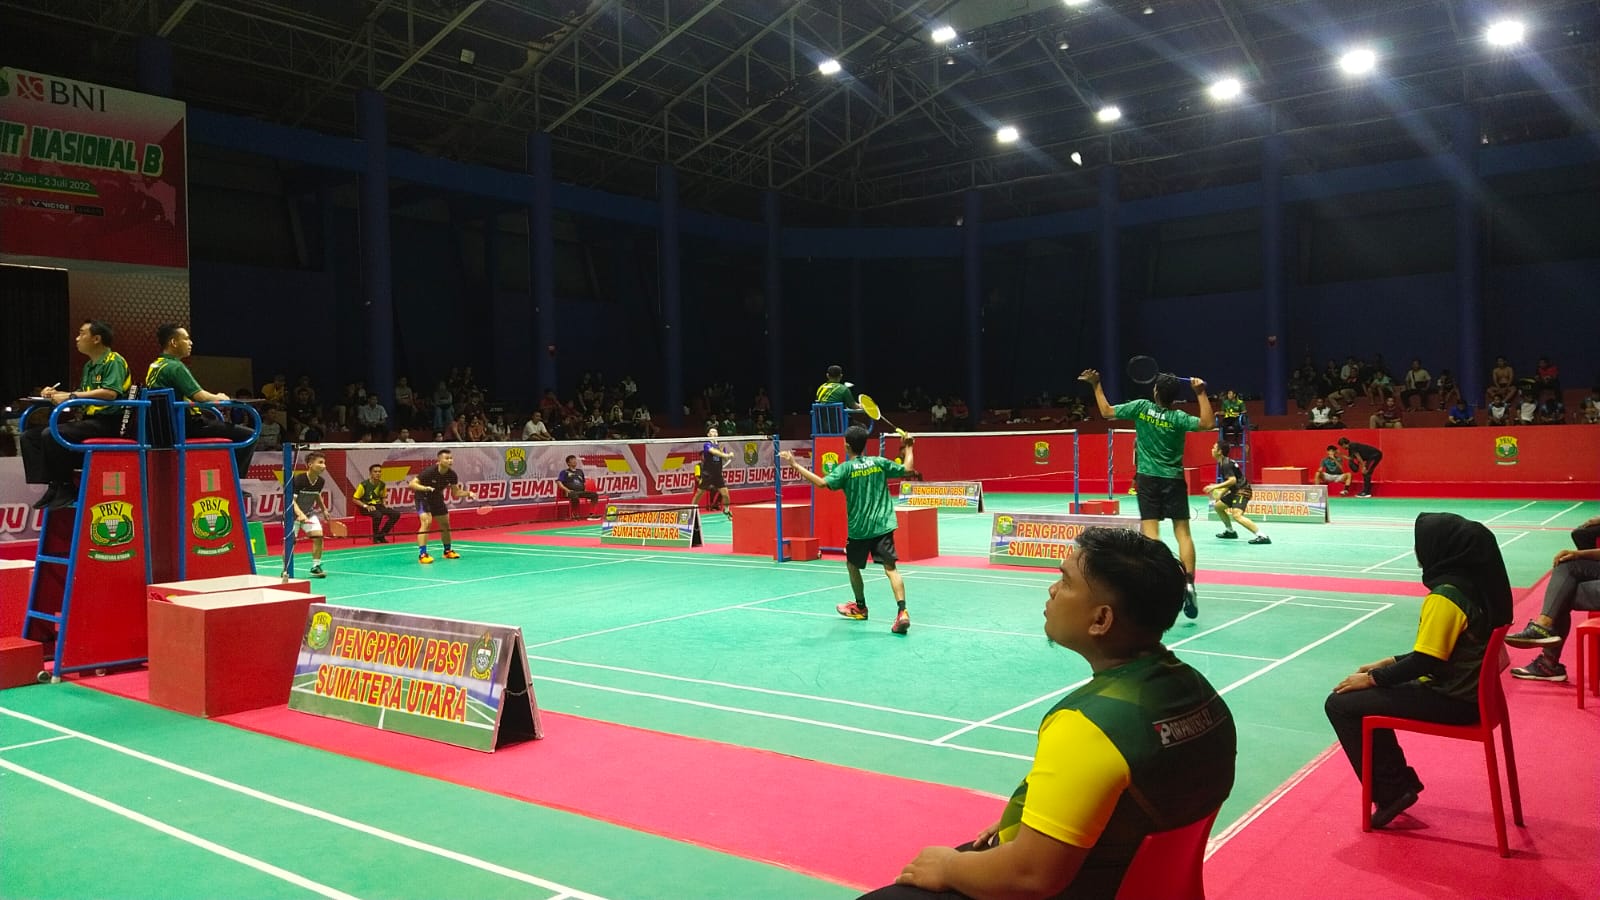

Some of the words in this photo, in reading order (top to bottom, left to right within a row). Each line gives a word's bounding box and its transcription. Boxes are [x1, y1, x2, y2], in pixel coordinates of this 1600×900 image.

[50, 80, 106, 112] BNI
[0, 121, 26, 156] IT
[31, 126, 138, 173] NASIONAL
[143, 145, 163, 176] B
[16, 173, 37, 184] Juni
[50, 178, 68, 188] Juli
[70, 180, 90, 191] 2022
[595, 475, 641, 493] UTARA
[908, 497, 943, 507] SUMATERA
[945, 498, 968, 507] UTARA
[1283, 491, 1305, 502] PBSI
[99, 503, 123, 517] PBSI
[199, 499, 221, 513] PBSI
[1277, 505, 1310, 516] UTARA
[617, 511, 659, 524] PENGPROV
[659, 511, 678, 524] PBSI
[612, 525, 652, 538] SUMATERA
[654, 527, 680, 539] UTARA
[331, 626, 422, 669] PENGPROV
[423, 638, 468, 677] PBSI
[315, 664, 402, 710] SUMATERA
[406, 679, 468, 723] UTARA
